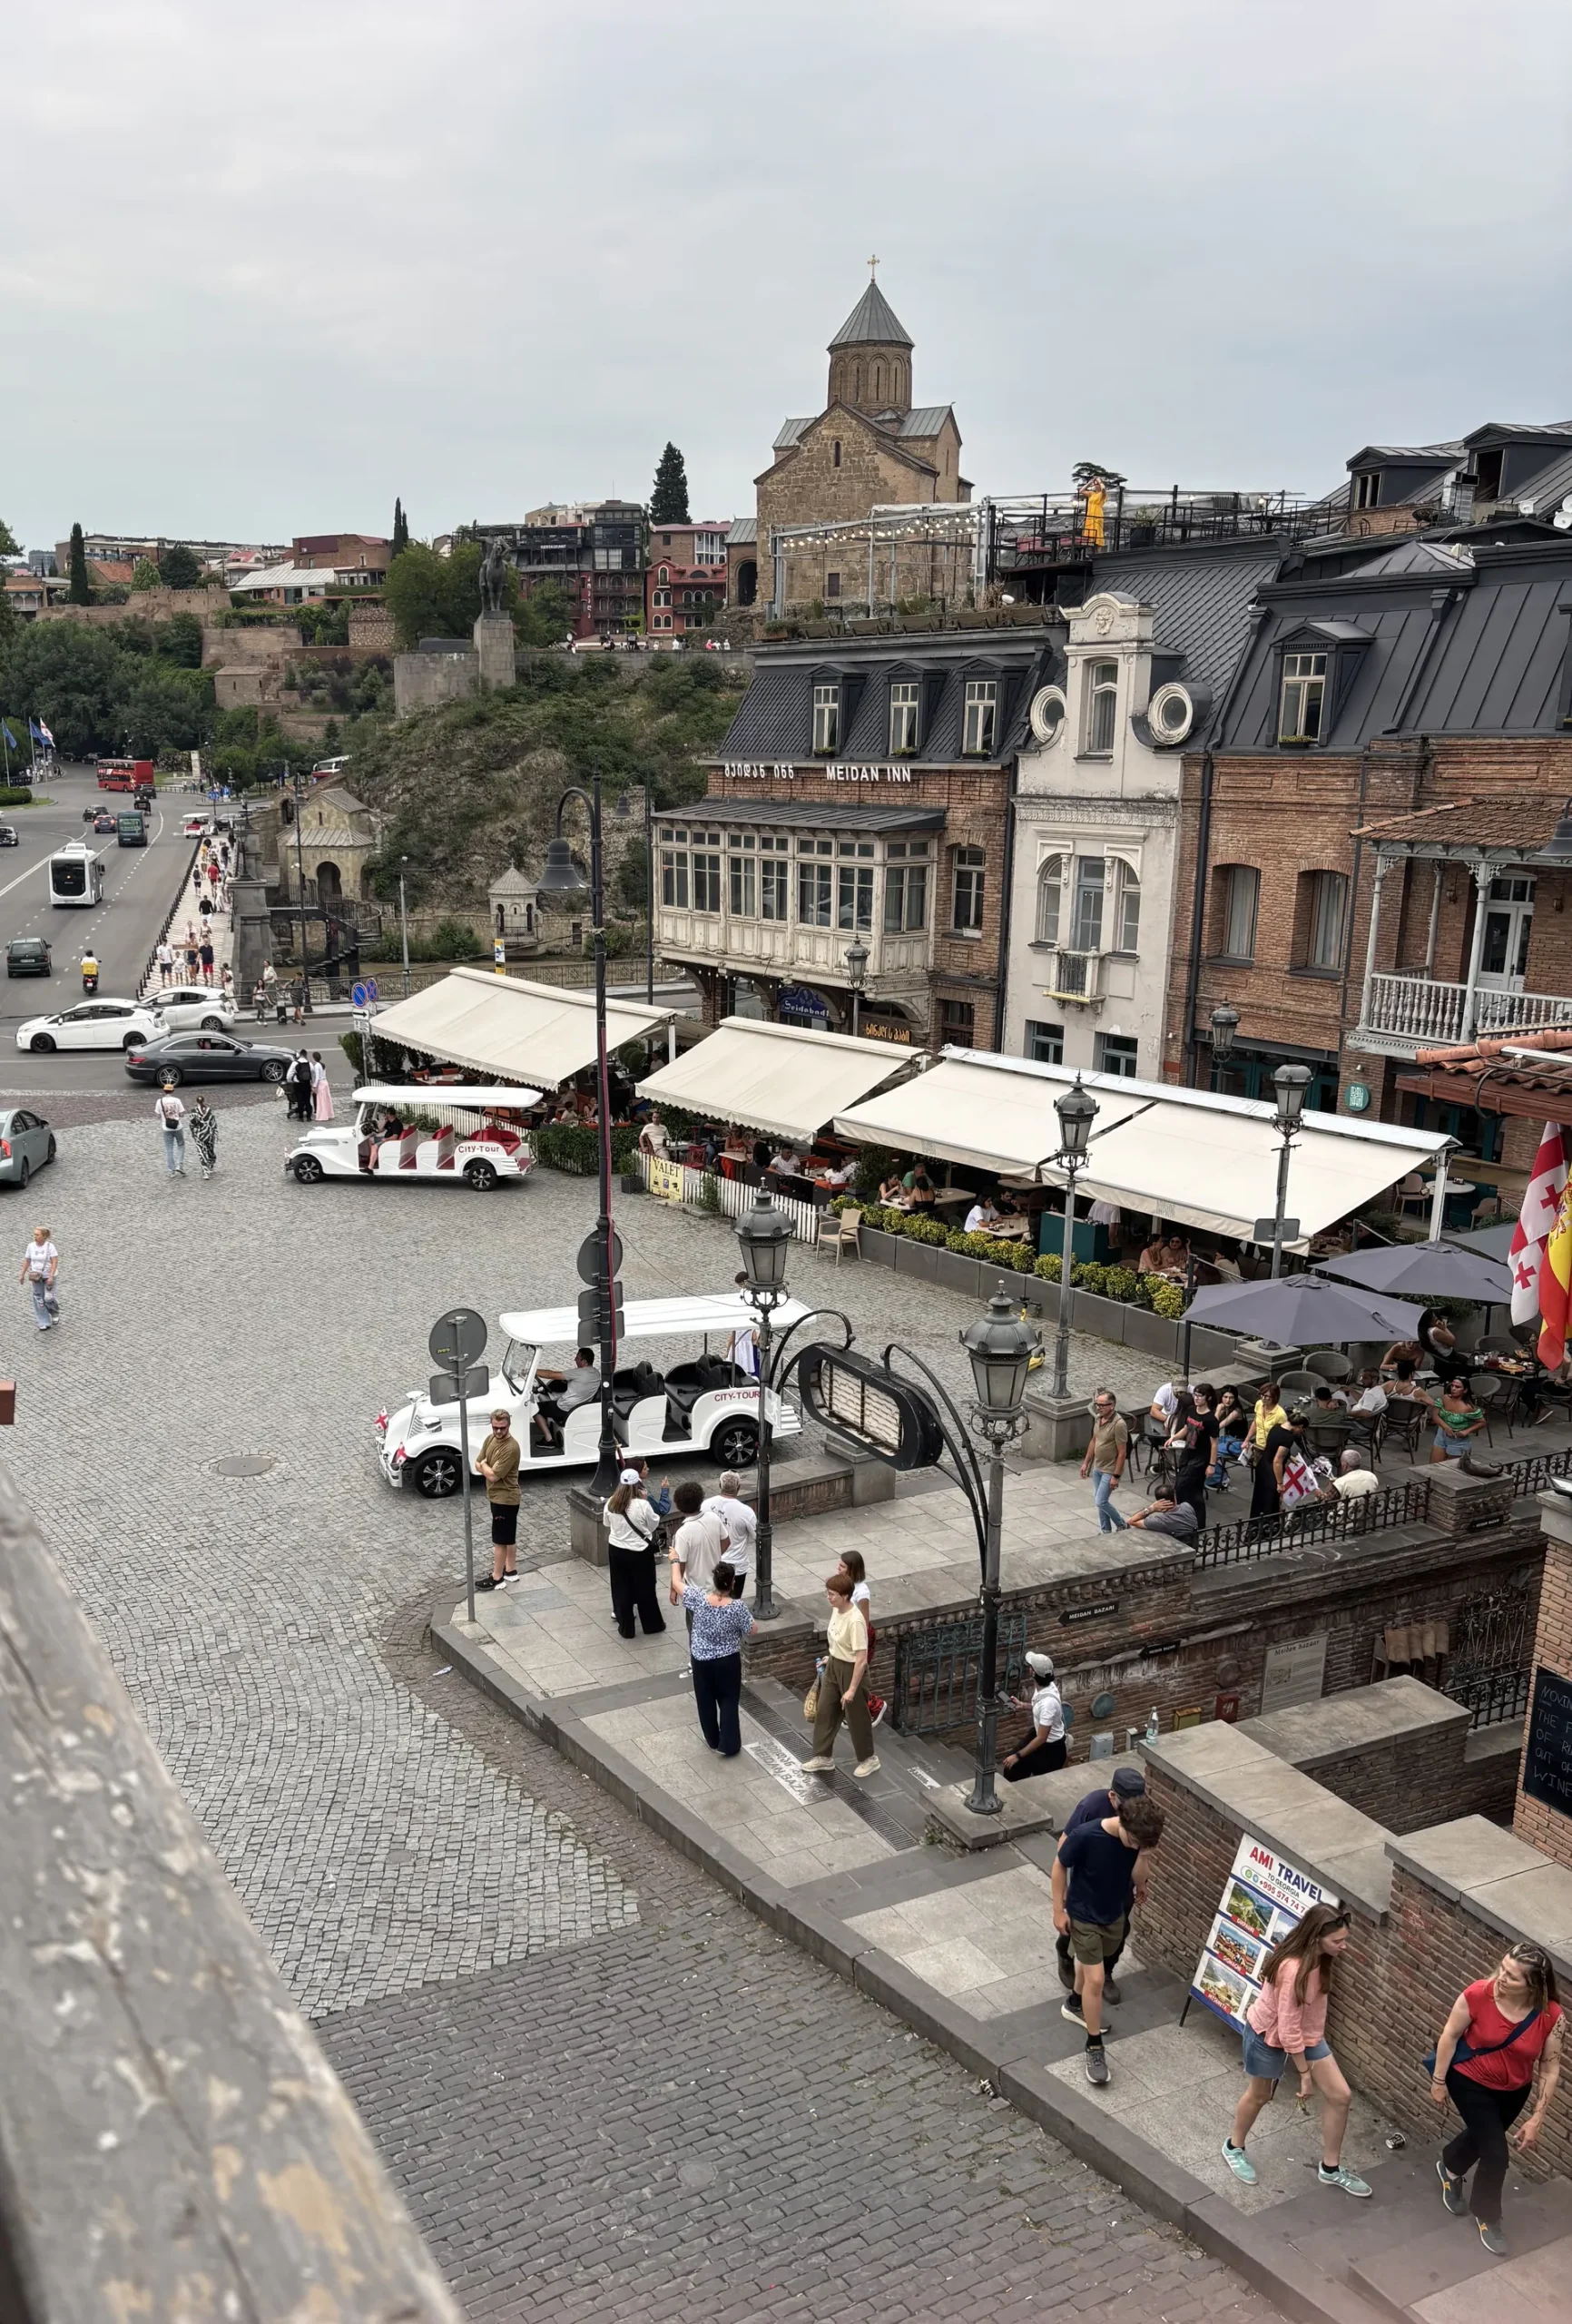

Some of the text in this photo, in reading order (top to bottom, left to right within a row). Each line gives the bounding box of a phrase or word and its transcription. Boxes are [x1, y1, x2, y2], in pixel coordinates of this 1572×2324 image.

[724, 763, 794, 780] მეიდან ინნ
[826, 765, 911, 783] MEIDAN INN
[653, 1159, 680, 1177] VALET
[714, 1390, 761, 1402] CITY-TOUR
[1068, 1604, 1115, 1620] MEIDAN BAZARI
[1538, 1708, 1558, 1728] THE
[1536, 1728, 1553, 1744] OF
[749, 1745, 785, 1776] MEIDAN
[1535, 1747, 1554, 1764] OUT
[1533, 1765, 1572, 1797] WINE
[1250, 1846, 1322, 1903] AMI TRAVEL
[1267, 1872, 1300, 1898] TO GEORGIA
[1259, 1880, 1276, 1895] +995
[1276, 1891, 1290, 1904] 574
[1291, 1899, 1299, 1911] 74
